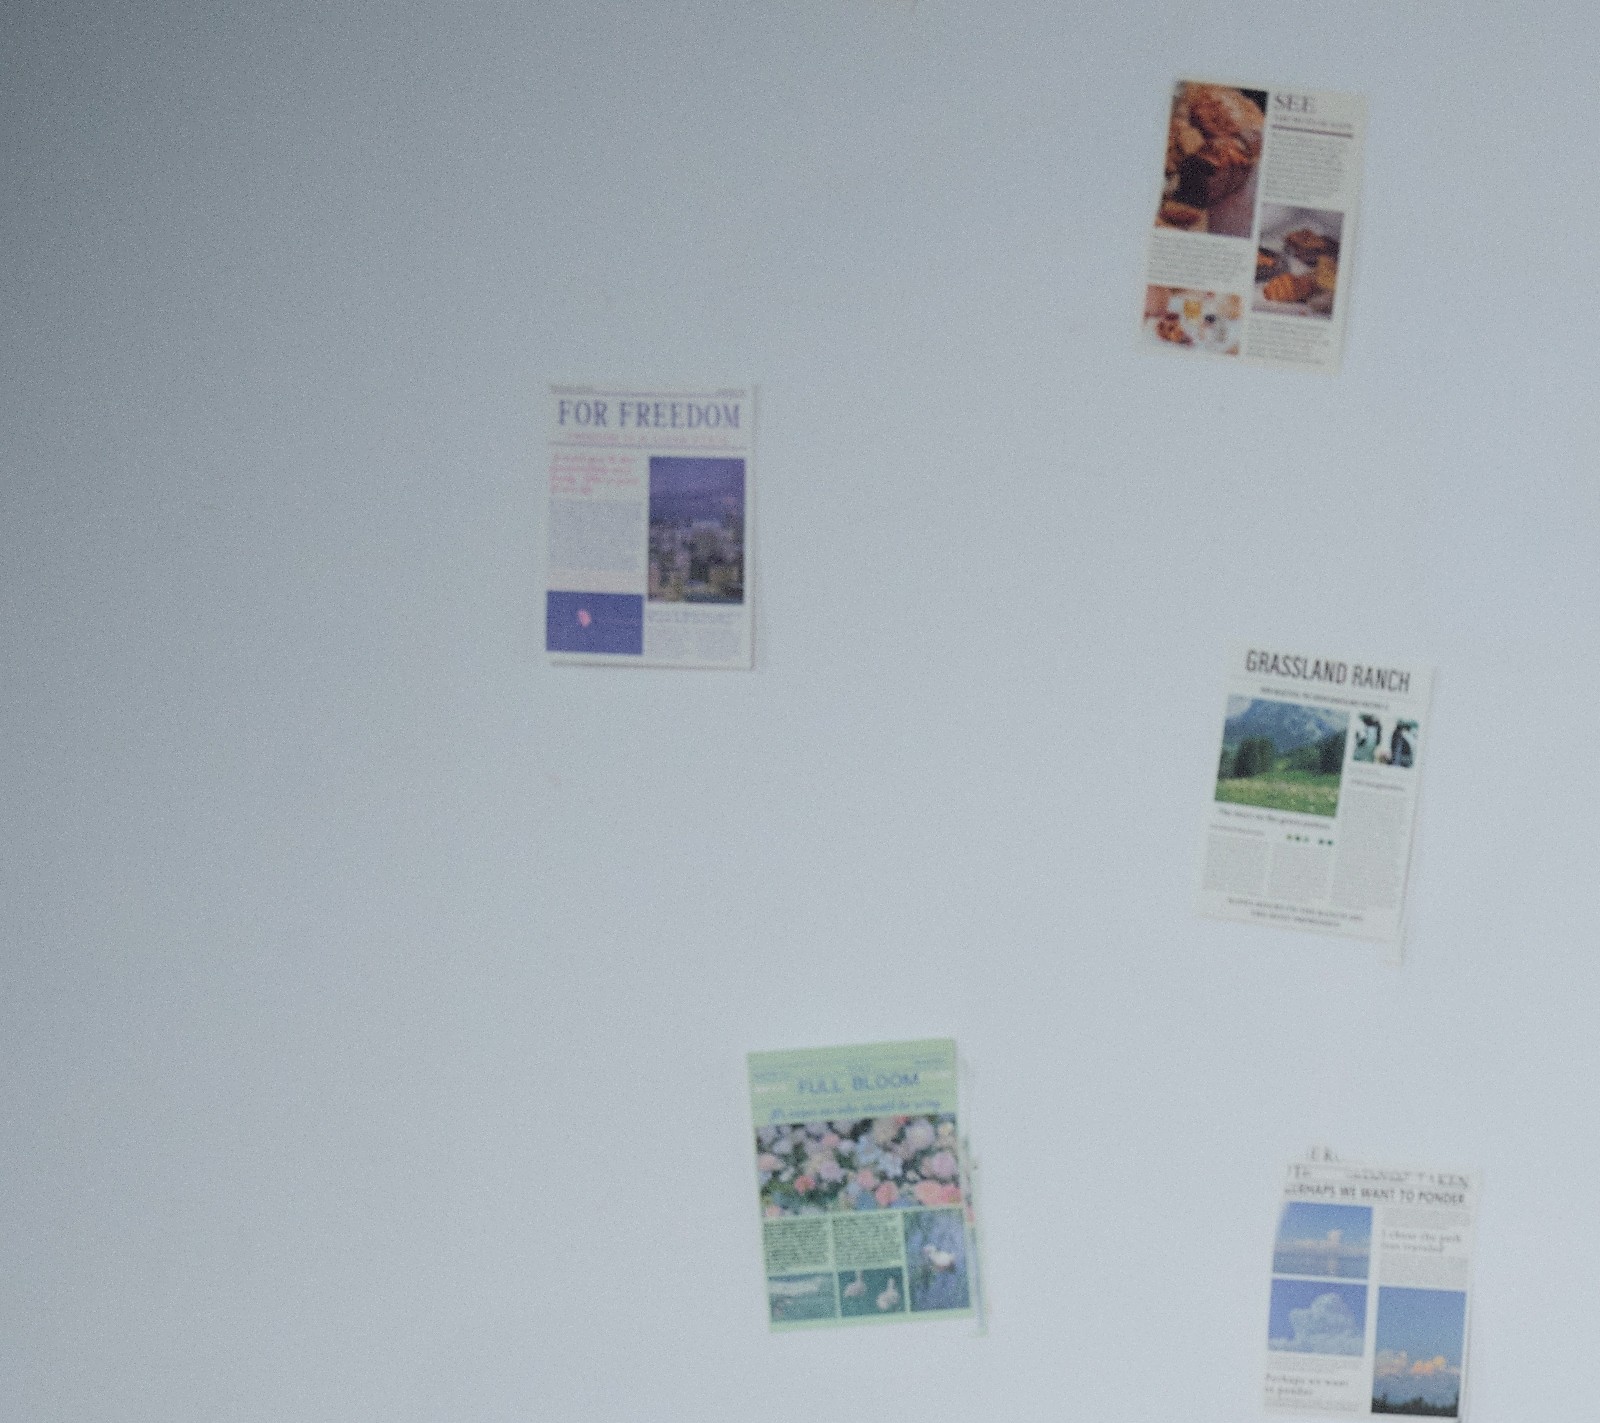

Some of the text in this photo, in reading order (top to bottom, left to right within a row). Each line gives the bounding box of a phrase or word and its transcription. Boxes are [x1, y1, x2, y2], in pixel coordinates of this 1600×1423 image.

[559, 399, 741, 429] FOR FREEDOM
[1245, 649, 1411, 693] GRASSLAND RANCH
[797, 1072, 920, 1095] FULL BLOOM
[1360, 1188, 1395, 1201] WANT
[1400, 1190, 1415, 1204] TO
[1418, 1191, 1465, 1206] PONDER
